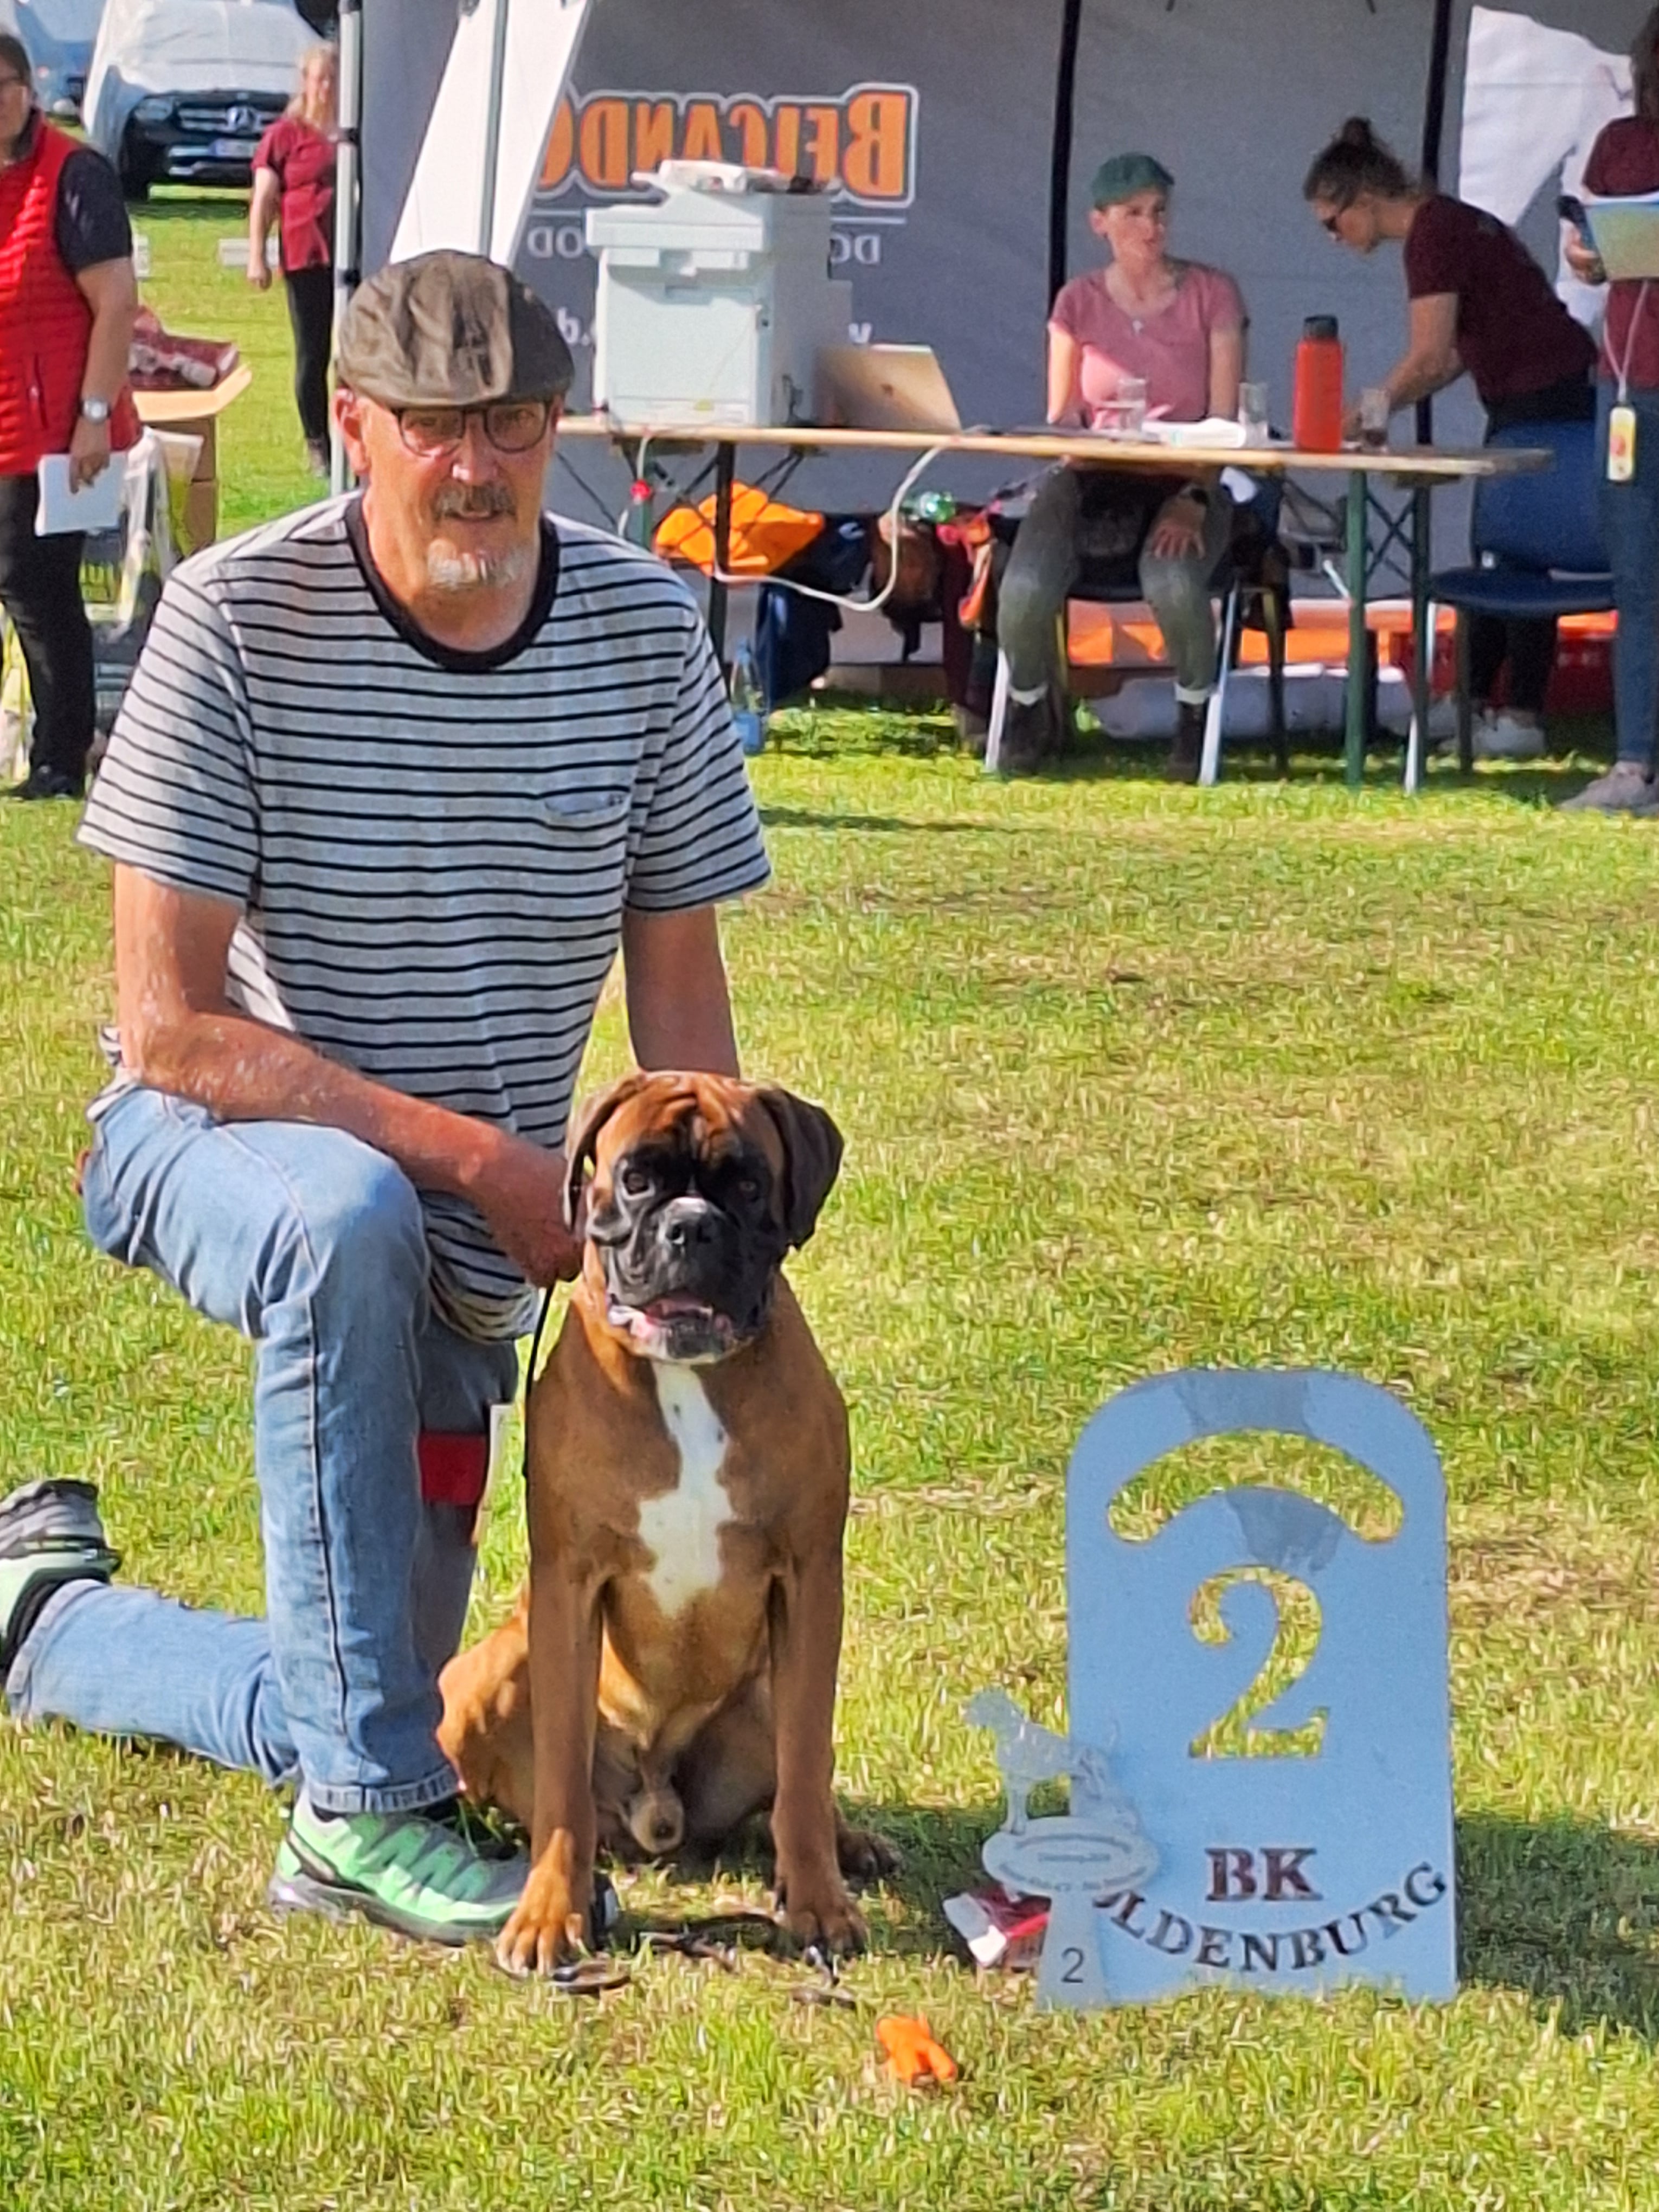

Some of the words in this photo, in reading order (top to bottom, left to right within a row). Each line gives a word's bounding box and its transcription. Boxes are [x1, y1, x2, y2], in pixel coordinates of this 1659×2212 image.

[1188, 1565, 1330, 1758] 2
[1205, 1847, 1323, 1901] BK
[1060, 1947, 1084, 1983] 2
